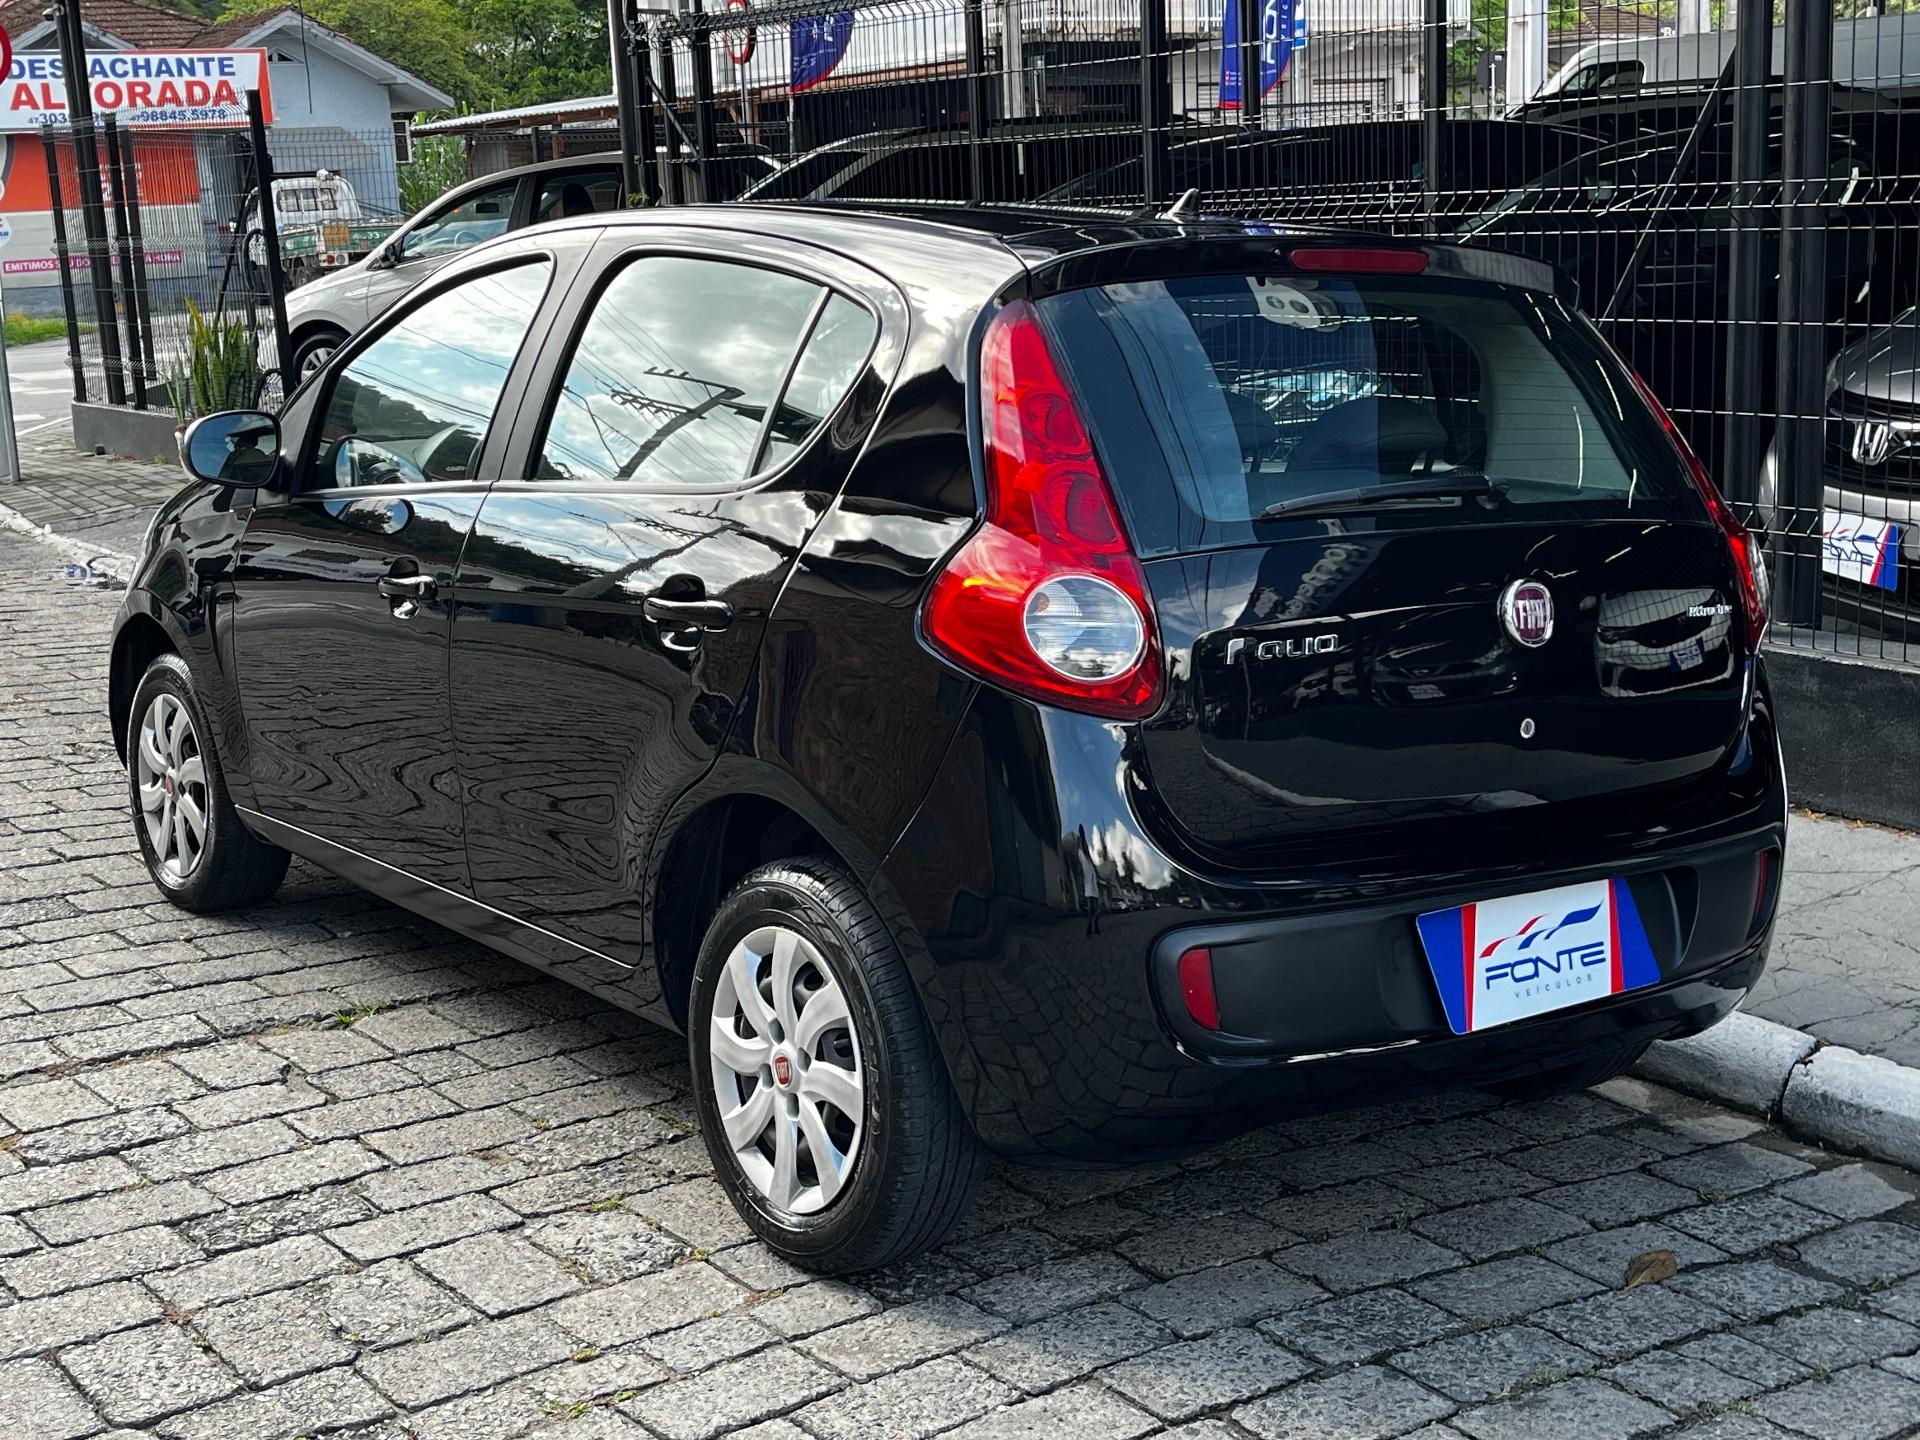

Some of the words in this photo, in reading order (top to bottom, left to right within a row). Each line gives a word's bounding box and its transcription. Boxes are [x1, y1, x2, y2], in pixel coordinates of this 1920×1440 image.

[7, 56, 236, 79] DESACHANTE
[10, 79, 240, 111] ALORADA
[5, 260, 54, 271] EMITIMOS
[1513, 598, 1546, 630] FIAT
[1485, 941, 1606, 990] FONTE
